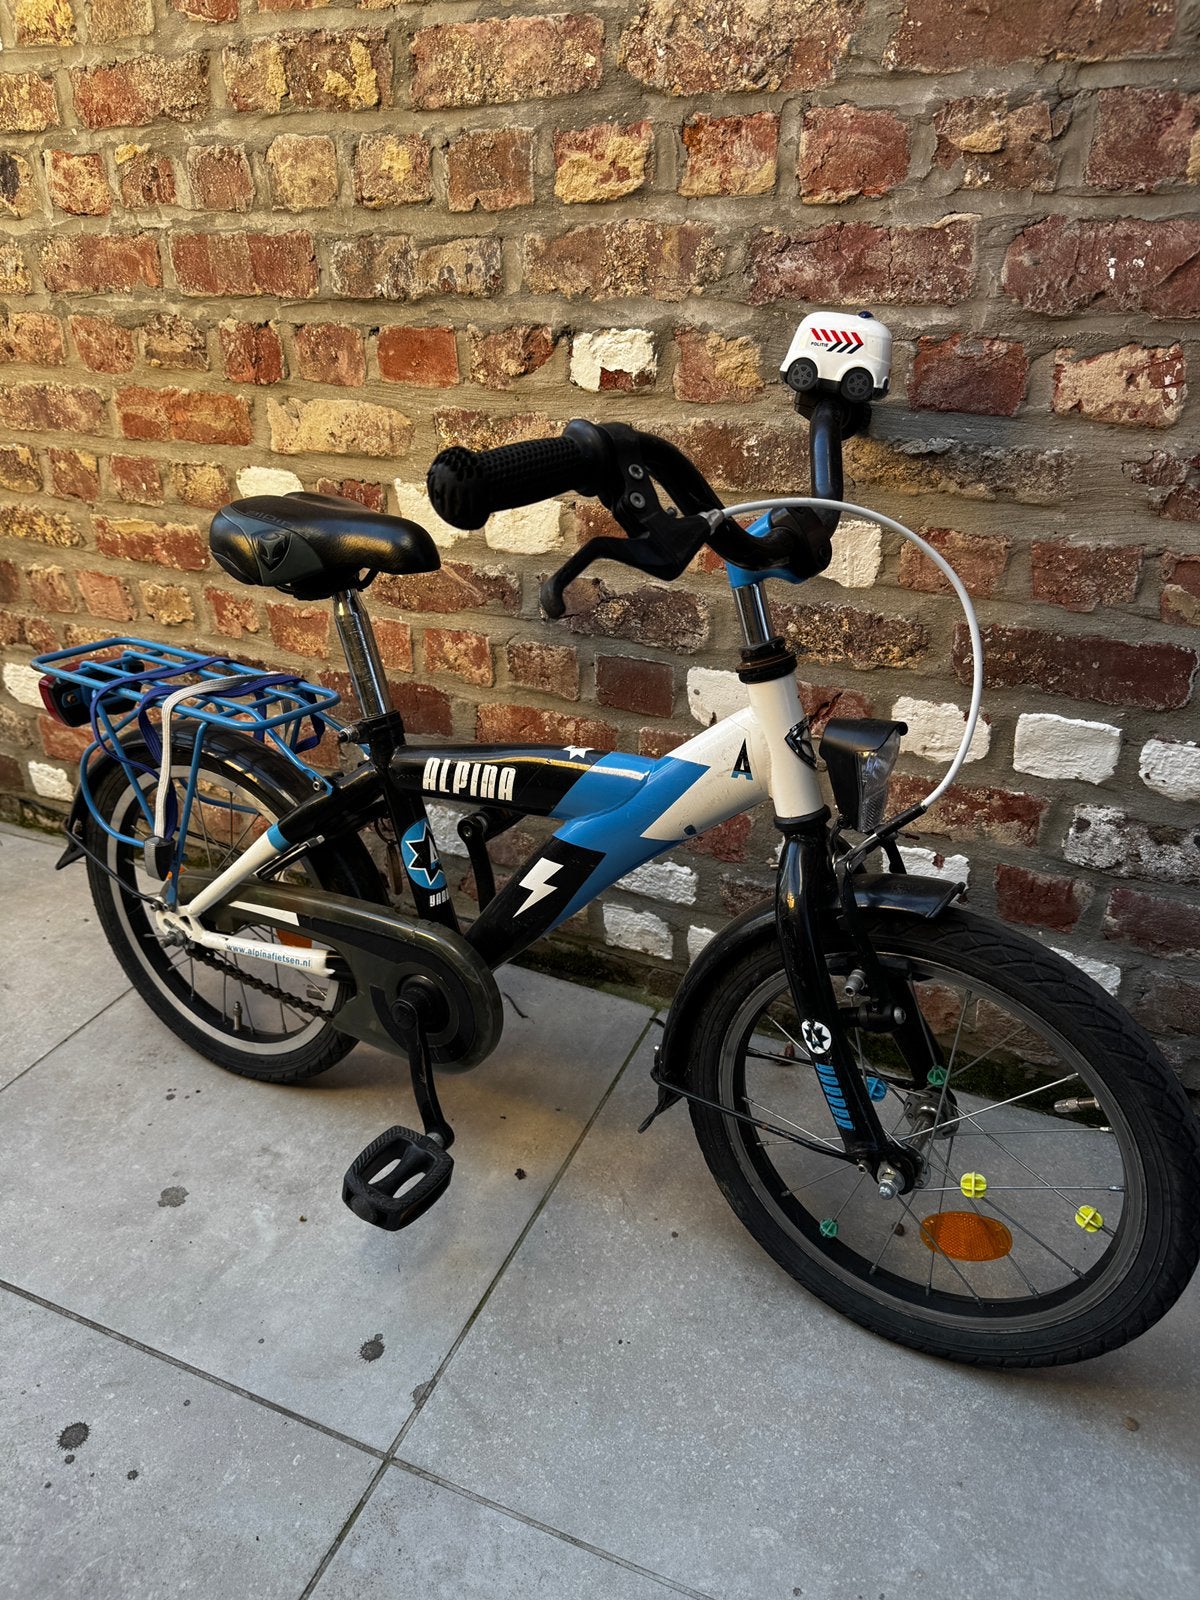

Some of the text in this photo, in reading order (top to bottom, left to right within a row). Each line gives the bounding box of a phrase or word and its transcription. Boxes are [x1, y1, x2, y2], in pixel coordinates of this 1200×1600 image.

[422, 757, 517, 802] ALPINA
[731, 737, 753, 781] A
[225, 944, 312, 968] www.alpinafietsen.nl
